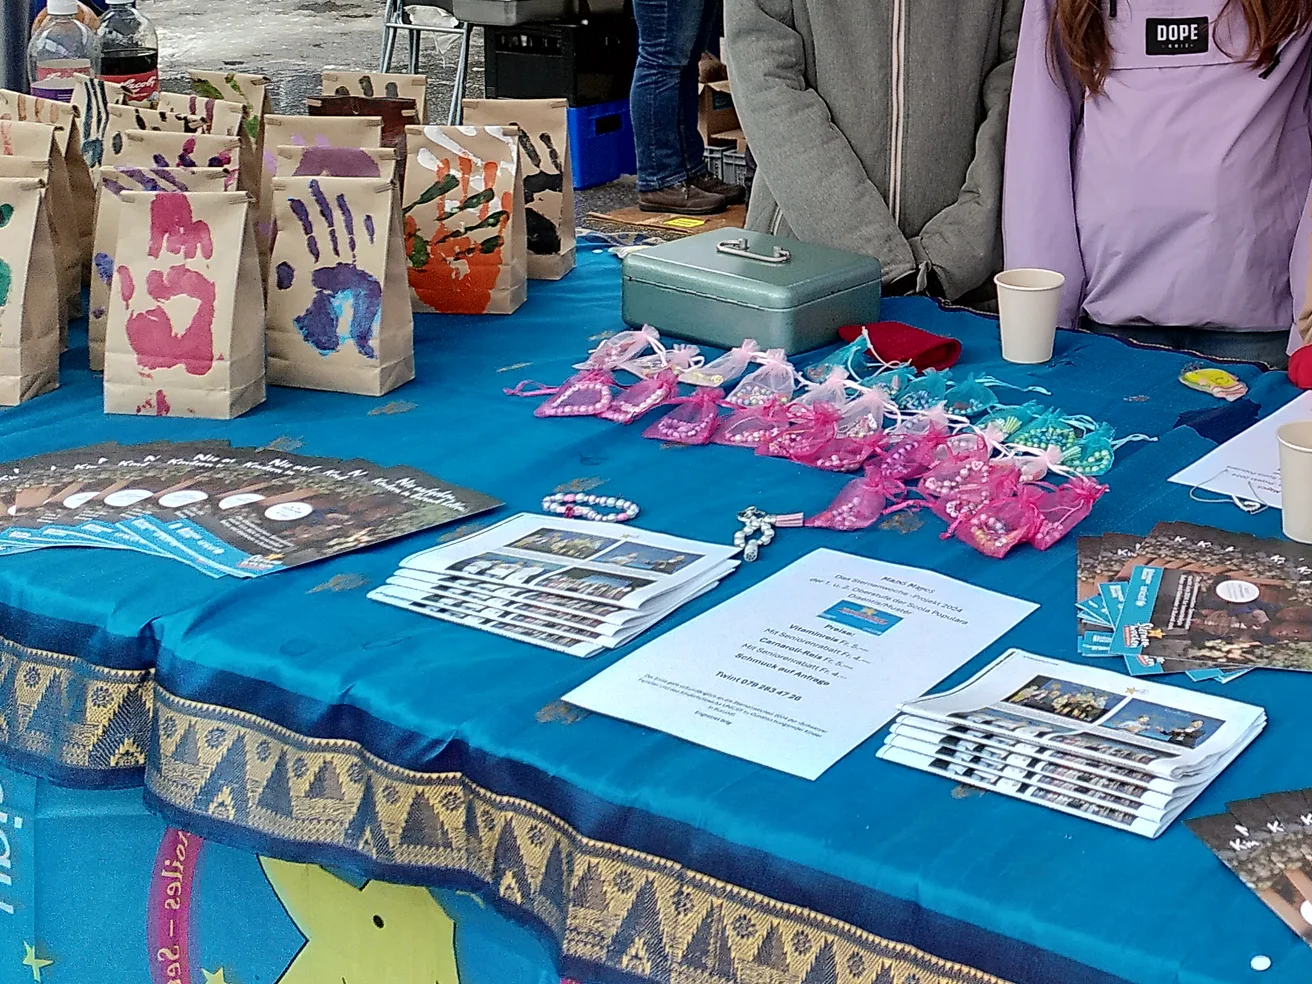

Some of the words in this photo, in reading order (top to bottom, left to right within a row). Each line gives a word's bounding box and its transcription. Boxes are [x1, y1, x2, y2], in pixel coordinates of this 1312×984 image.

[1157, 24, 1198, 41] DOPE
[941, 604, 963, 613] 2024
[764, 628, 780, 636] Mit
[789, 624, 840, 643] Vitaminreis
[741, 643, 757, 651] Mit
[735, 653, 778, 669] Schmuck
[793, 672, 830, 686] Anfrage
[715, 671, 741, 682] Twint
